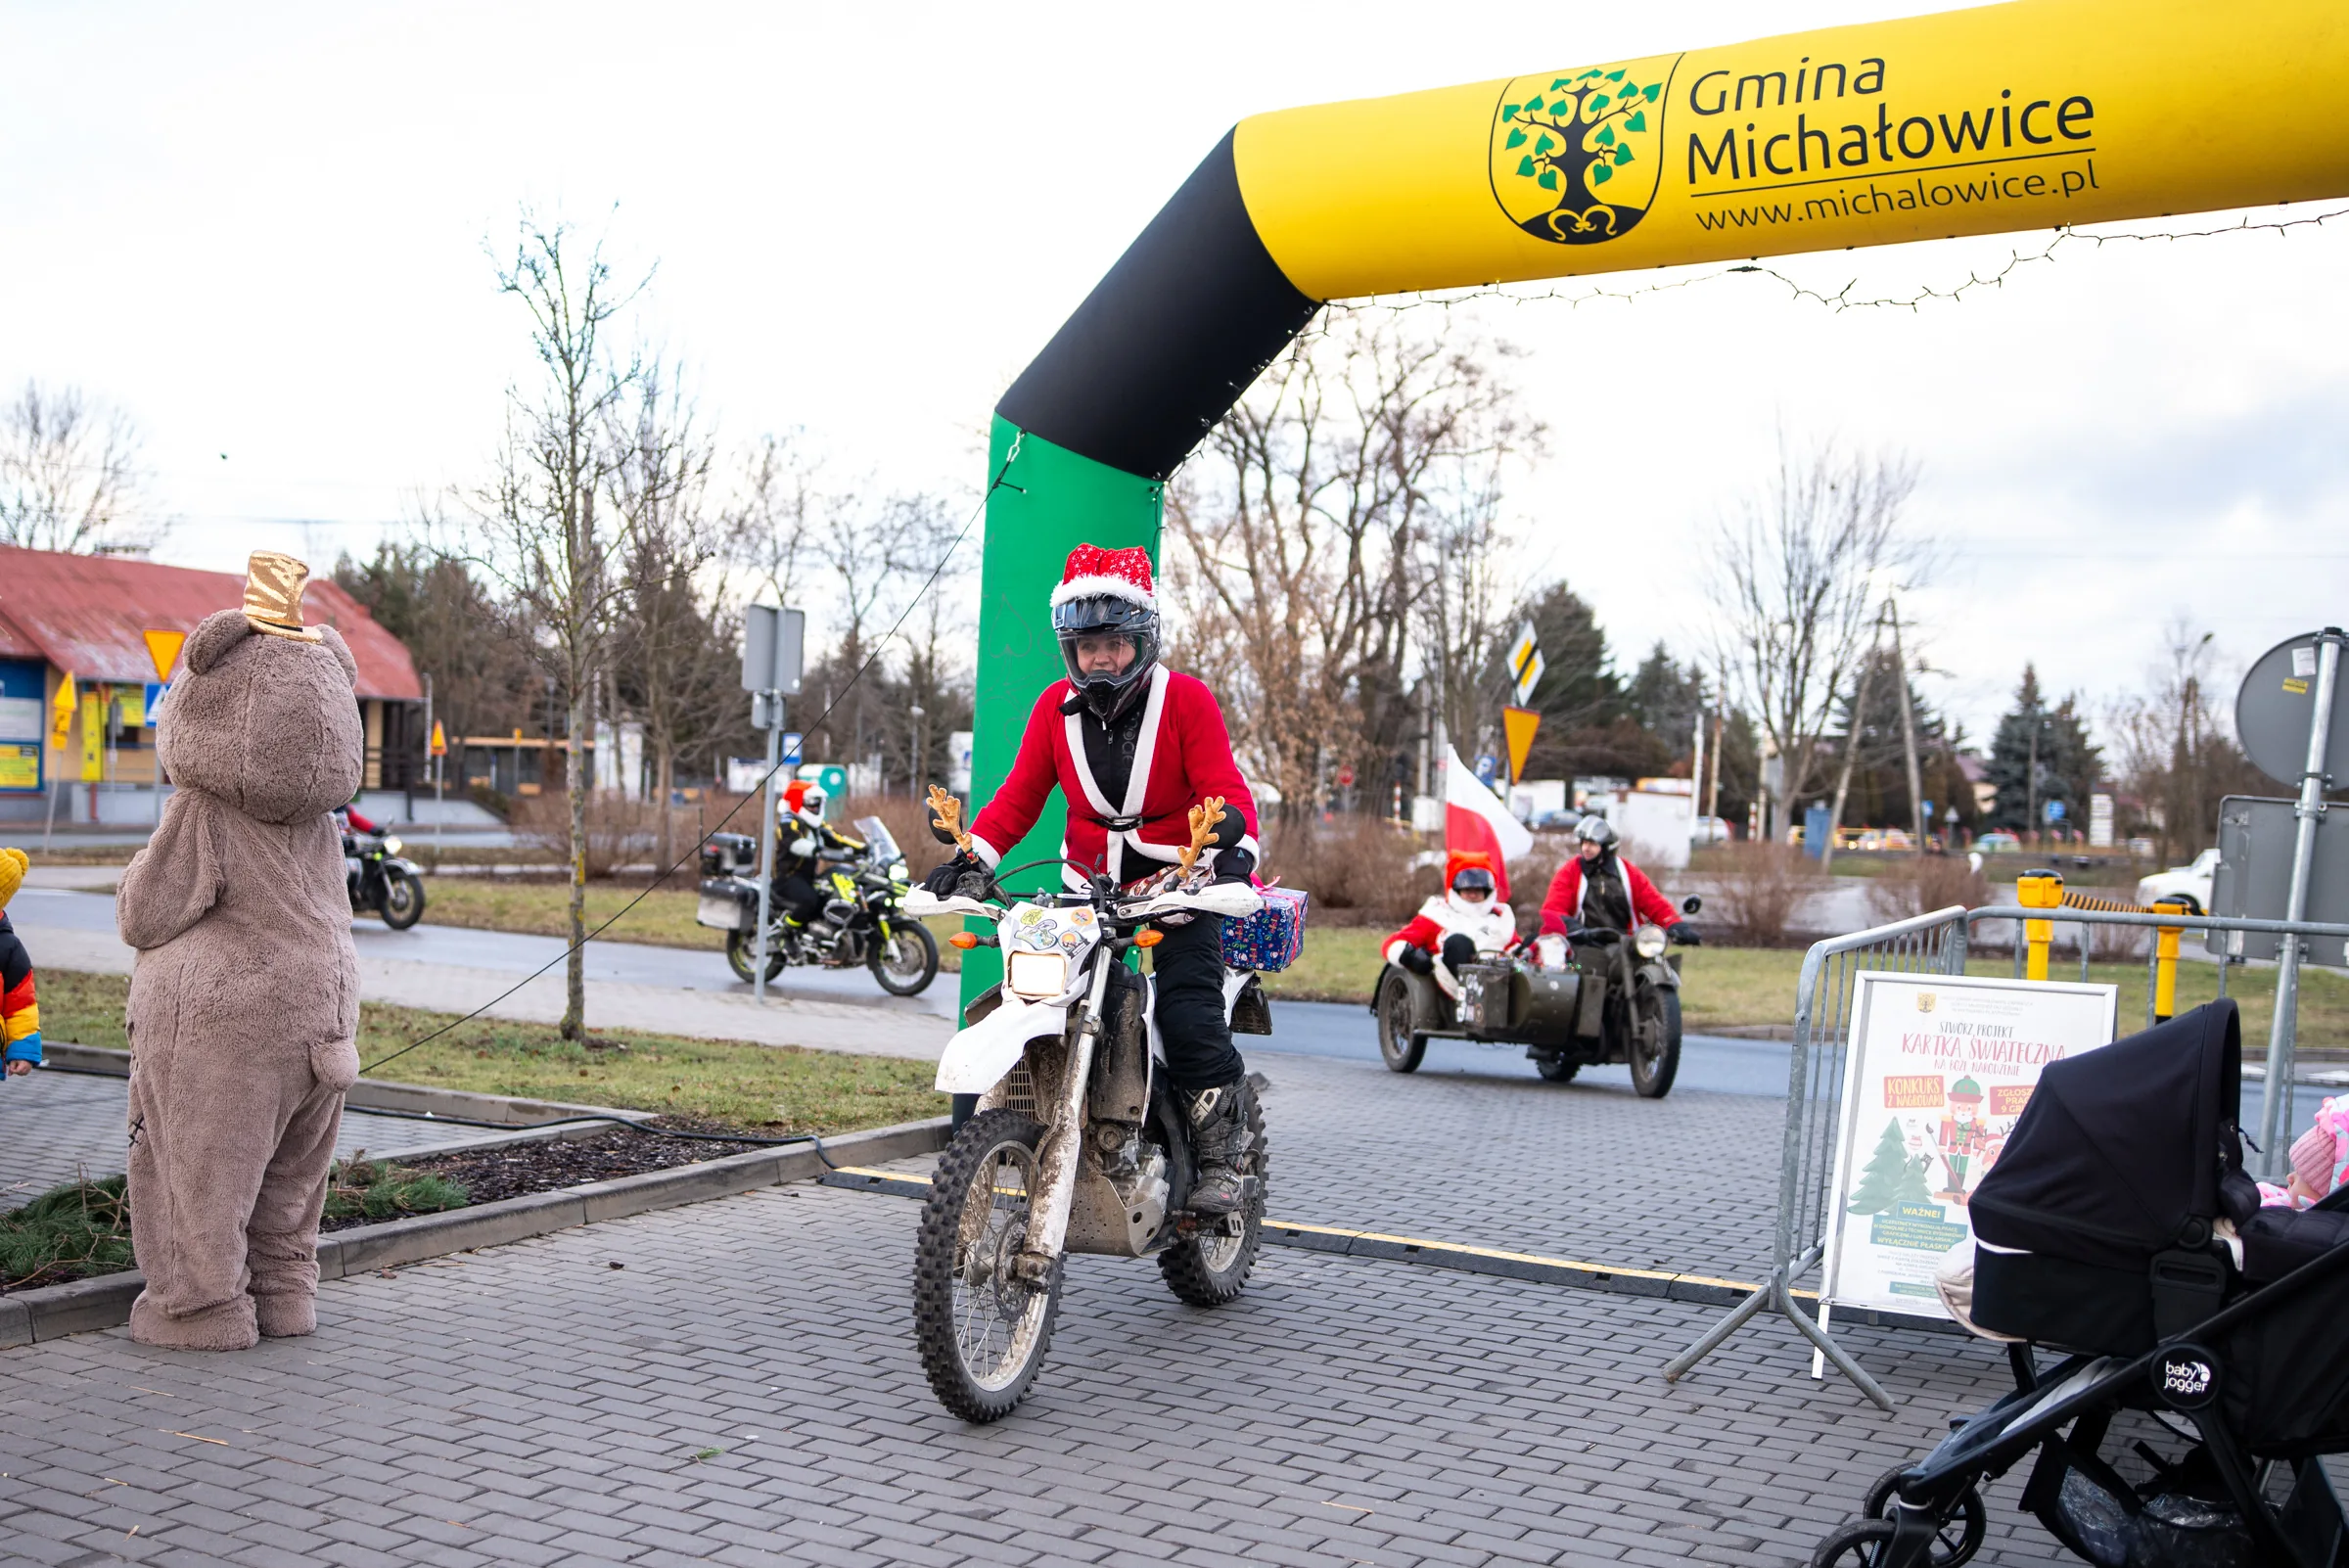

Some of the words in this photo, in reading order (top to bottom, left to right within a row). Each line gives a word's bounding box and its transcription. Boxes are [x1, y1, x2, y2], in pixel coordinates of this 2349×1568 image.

[1689, 56, 1885, 115] Gmina
[1688, 88, 2095, 185] Michałowice
[1695, 159, 2100, 232] www.michalowice.pl
[1977, 1024, 2014, 1038] PROJEKT
[1902, 1033, 1961, 1058] KARTKA
[1934, 1059, 1946, 1070] NA
[1971, 1062, 2020, 1077] NARODZENIE
[1887, 1078, 1940, 1095] KONKURS
[1887, 1094, 1893, 1107] Z
[1896, 1093, 1943, 1107] NAGRODAMI
[2001, 1105, 2007, 1114] 9
[1902, 1205, 1941, 1219] WAŻNE!
[2165, 1360, 2197, 1381] baby
[2164, 1374, 2208, 1394] jogger
